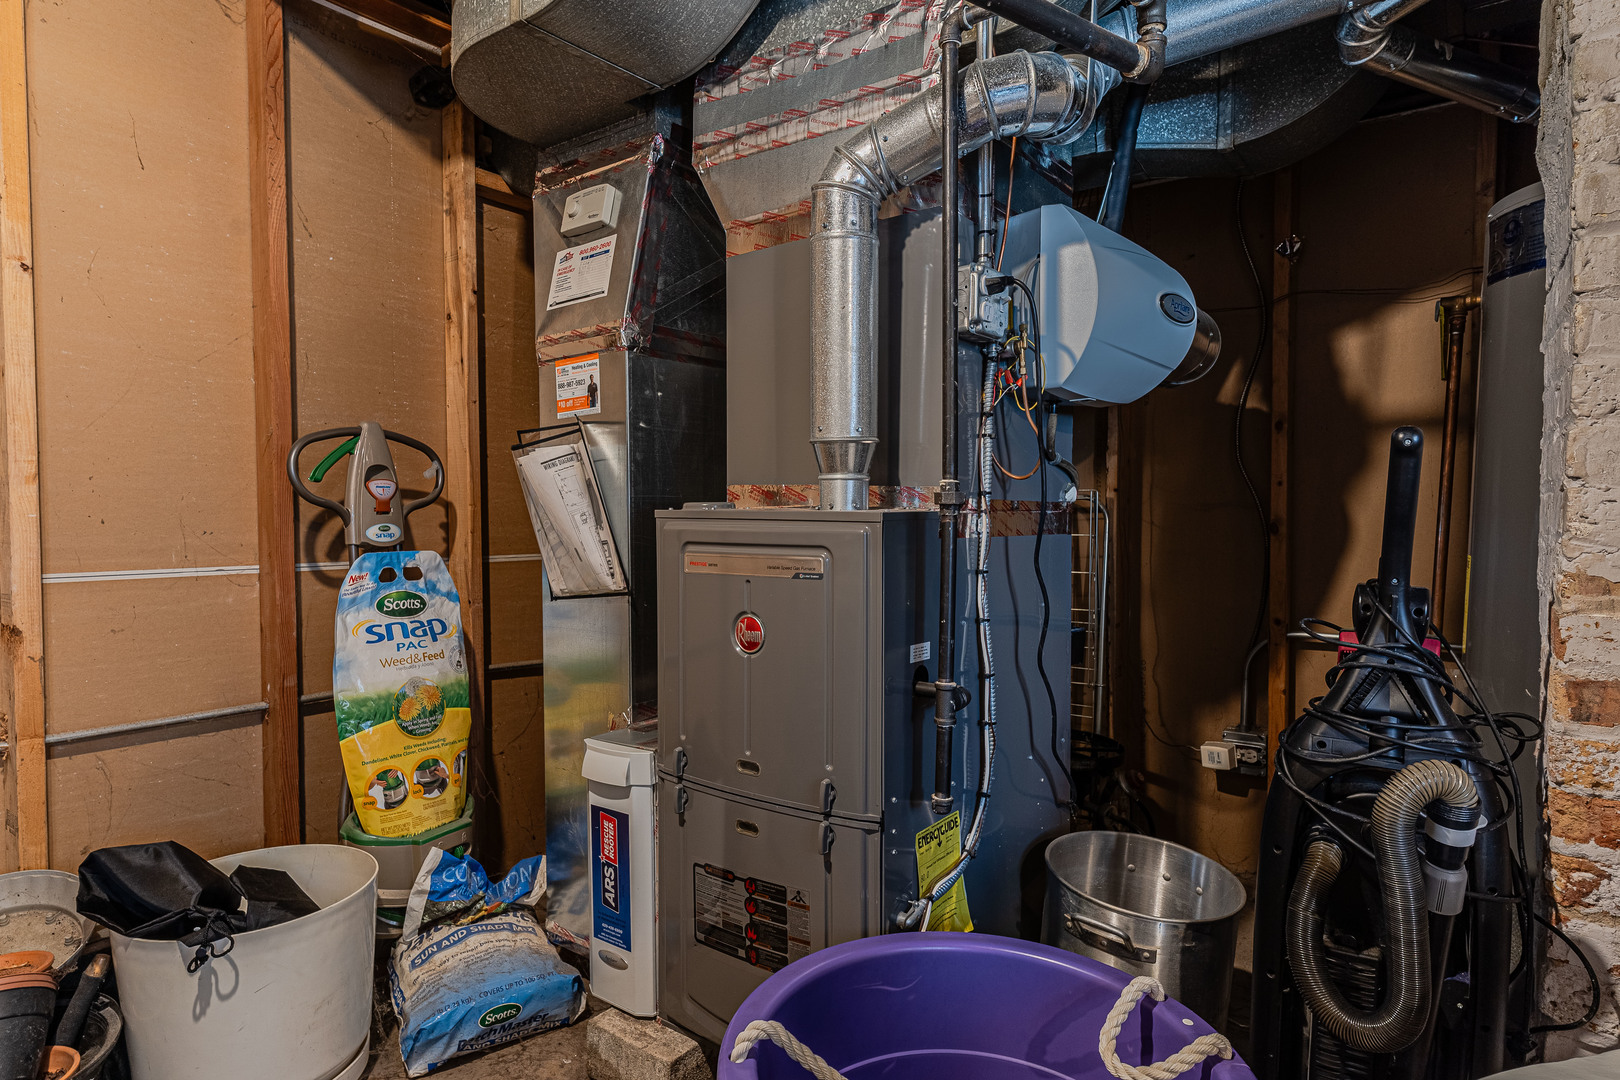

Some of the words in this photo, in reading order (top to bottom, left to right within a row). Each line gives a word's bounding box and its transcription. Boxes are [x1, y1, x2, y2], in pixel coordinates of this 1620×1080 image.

[348, 572, 369, 584] New!
[383, 597, 421, 611] Scotts
[365, 618, 448, 644] snap
[738, 618, 761, 646] Rheem
[396, 640, 429, 652] PAC
[379, 649, 445, 669] Weed&Feed
[604, 865, 616, 907] ARS
[414, 945, 438, 966] SUN
[441, 929, 468, 949] AND
[469, 923, 511, 933] SHADE
[479, 986, 504, 998] COVERS
[505, 982, 514, 990] UP
[485, 1008, 517, 1025] Scotts
